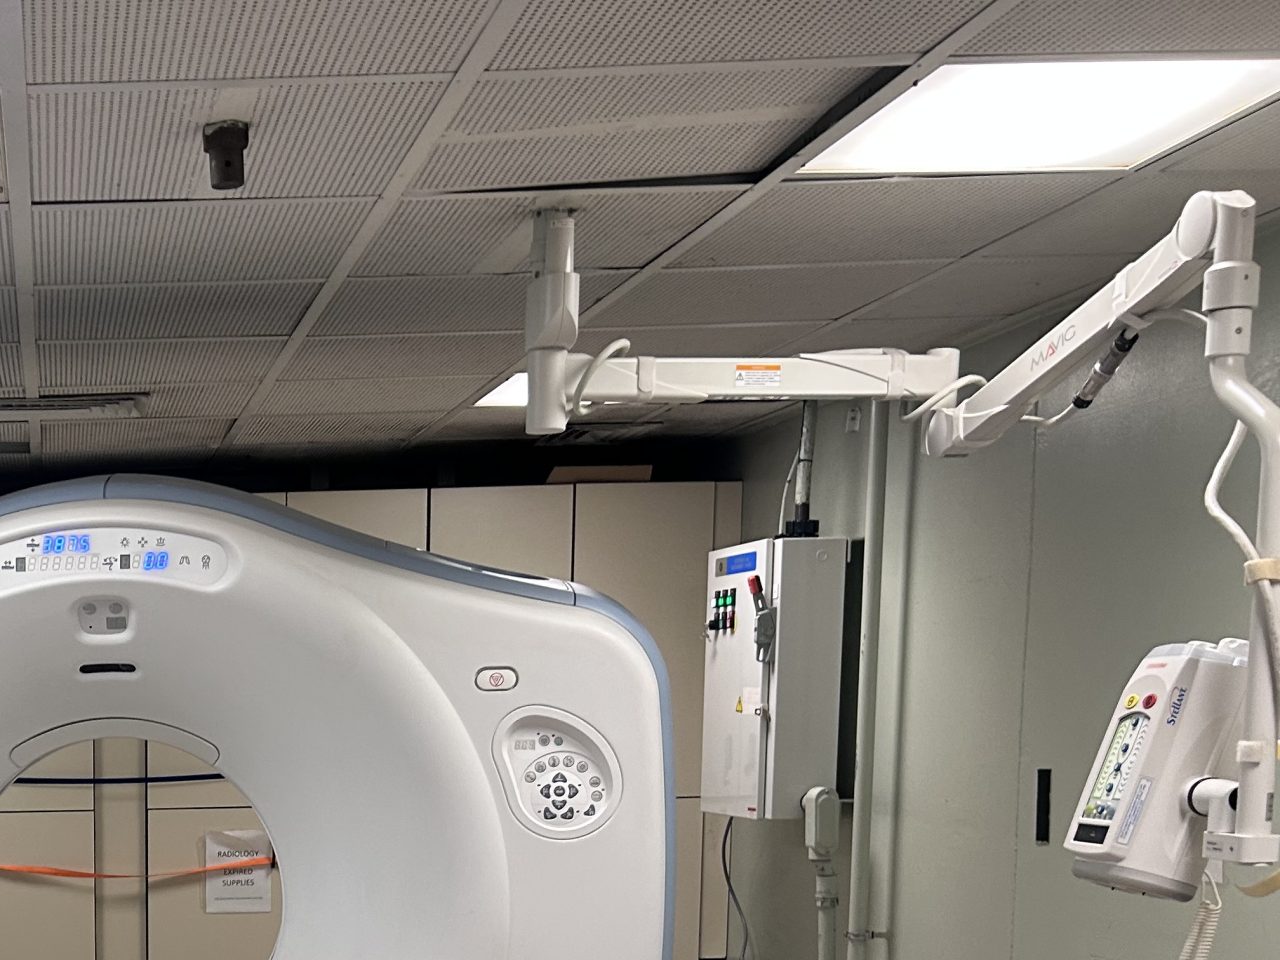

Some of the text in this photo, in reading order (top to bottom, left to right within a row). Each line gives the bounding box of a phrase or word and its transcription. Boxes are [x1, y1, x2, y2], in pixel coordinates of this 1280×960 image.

[1030, 324, 1077, 371] MAVIG
[217, 850, 260, 858] RADIOLOGY
[223, 868, 254, 876] EXPIRED
[222, 879, 255, 887] SUPPLIES
